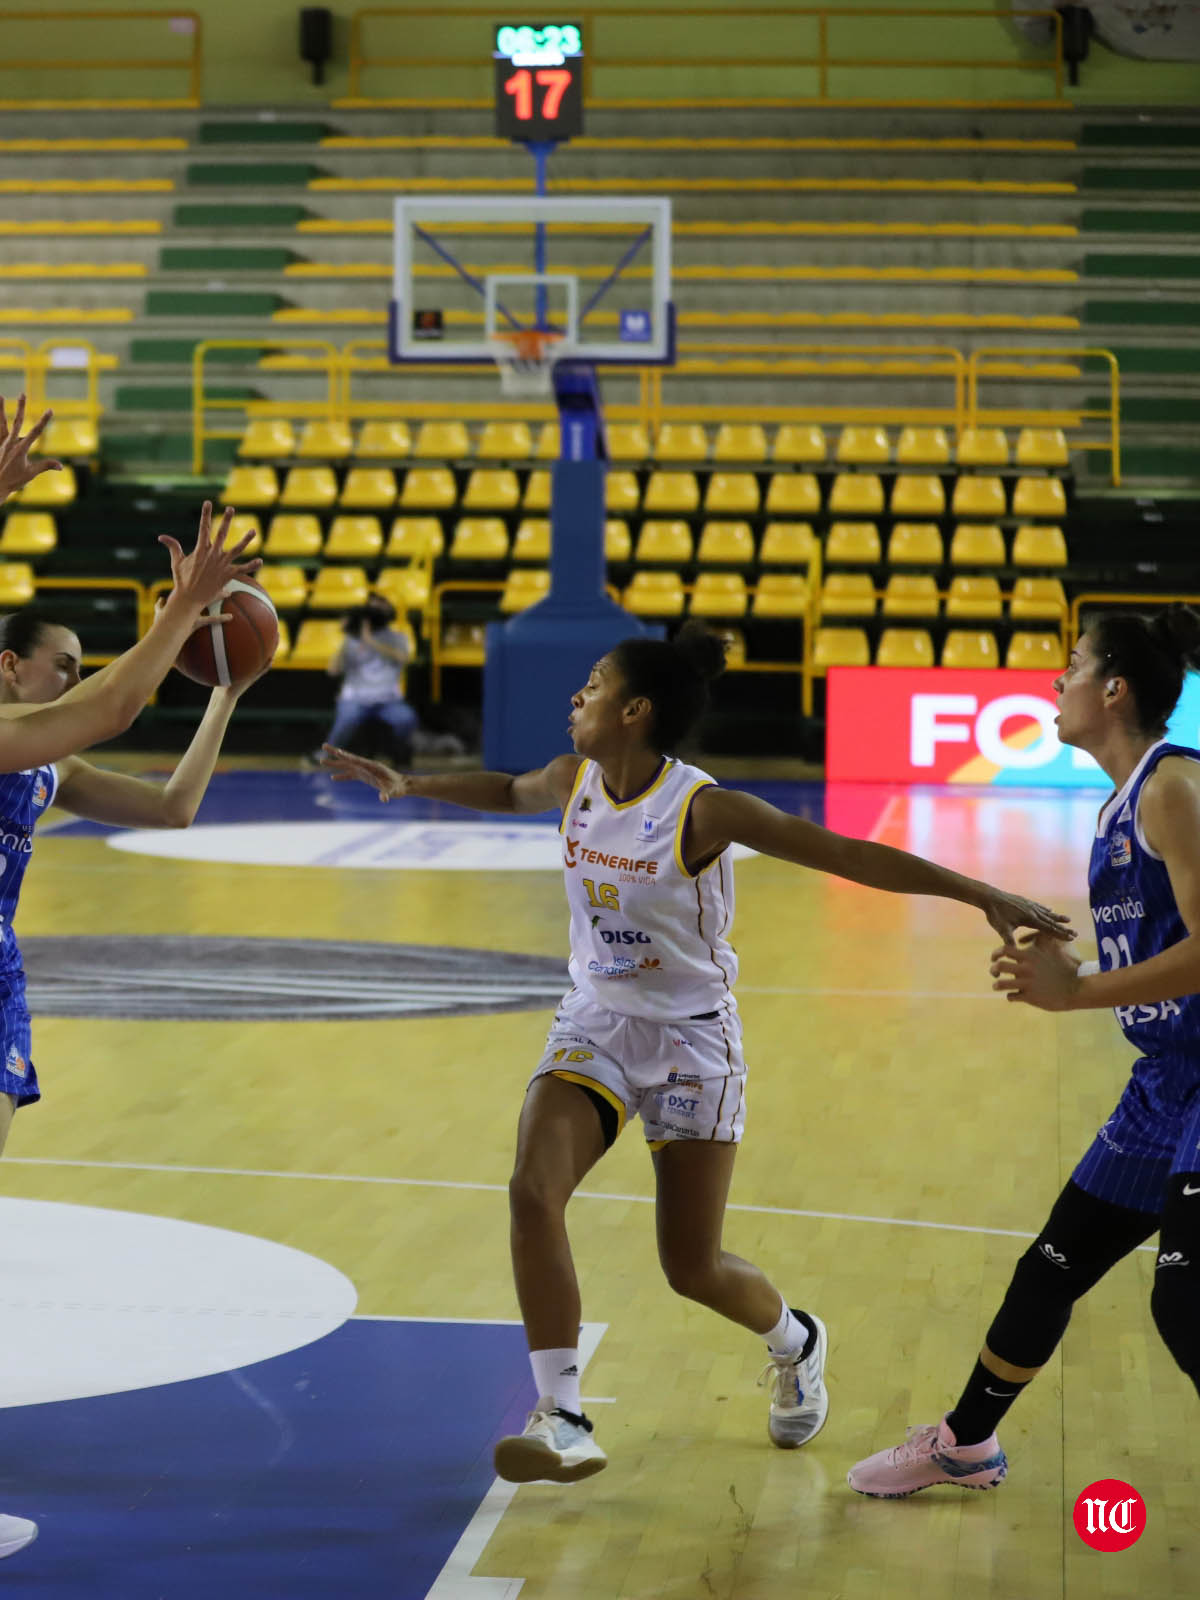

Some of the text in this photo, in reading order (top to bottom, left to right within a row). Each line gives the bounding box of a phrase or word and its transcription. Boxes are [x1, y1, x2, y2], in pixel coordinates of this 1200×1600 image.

[504, 69, 572, 120] 17
[910, 694, 1064, 768] FO
[580, 848, 658, 875] TENERIFE
[582, 878, 620, 912] 16
[1091, 897, 1145, 924] venida
[668, 1094, 700, 1112] DXT
